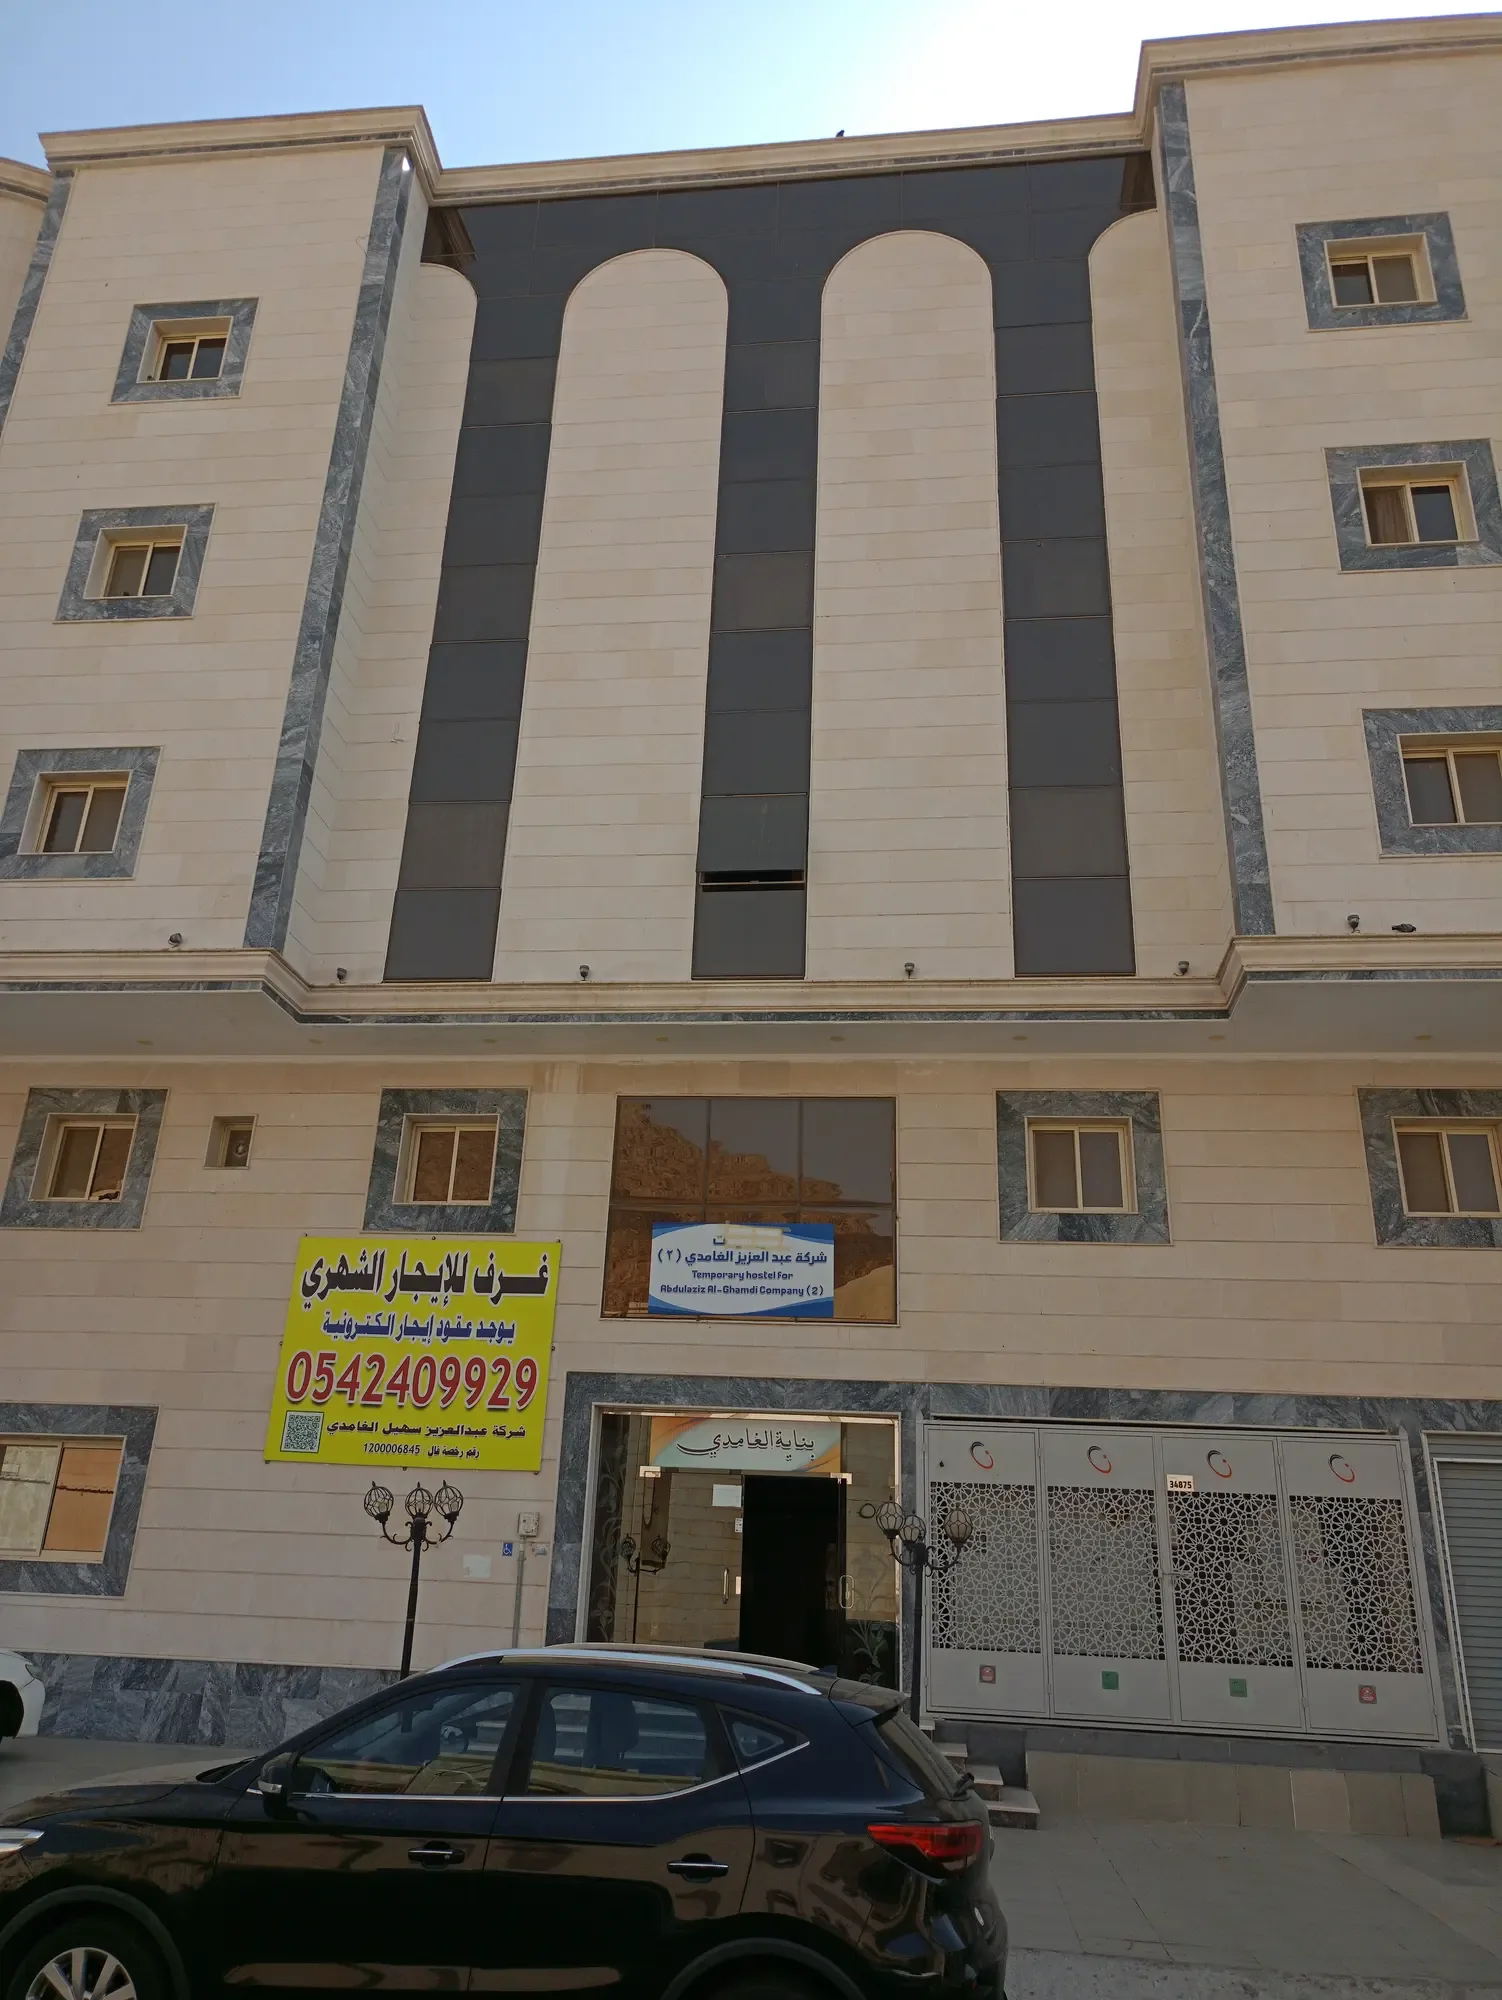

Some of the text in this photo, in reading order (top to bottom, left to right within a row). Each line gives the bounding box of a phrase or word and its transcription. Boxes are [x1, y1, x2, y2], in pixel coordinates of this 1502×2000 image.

[684, 1250, 734, 1267] الغامدي
[734, 1250, 769, 1266] العزيز
[771, 1253, 792, 1266] عبد
[795, 1251, 828, 1266] شركة
[301, 1248, 549, 1310] غرف للإيجار الشهري
[691, 1269, 745, 1281] Temporary
[745, 1270, 776, 1280] hostel
[660, 1284, 706, 1294] Abdulaziz
[707, 1285, 759, 1295] Al-Ghamdi
[759, 1285, 804, 1297] Company
[322, 1311, 516, 1345] يوجد عقود إيجار الكترونية
[286, 1350, 538, 1408] 0542409929
[326, 1420, 379, 1435] الغامدي
[381, 1421, 422, 1436] سهيل
[491, 1424, 526, 1439] شركة
[363, 1442, 480, 1459] رقم رخصة فال 1200006845
[676, 1427, 815, 1461] بناية الغامدي
[1169, 1480, 1192, 1489] 34875
